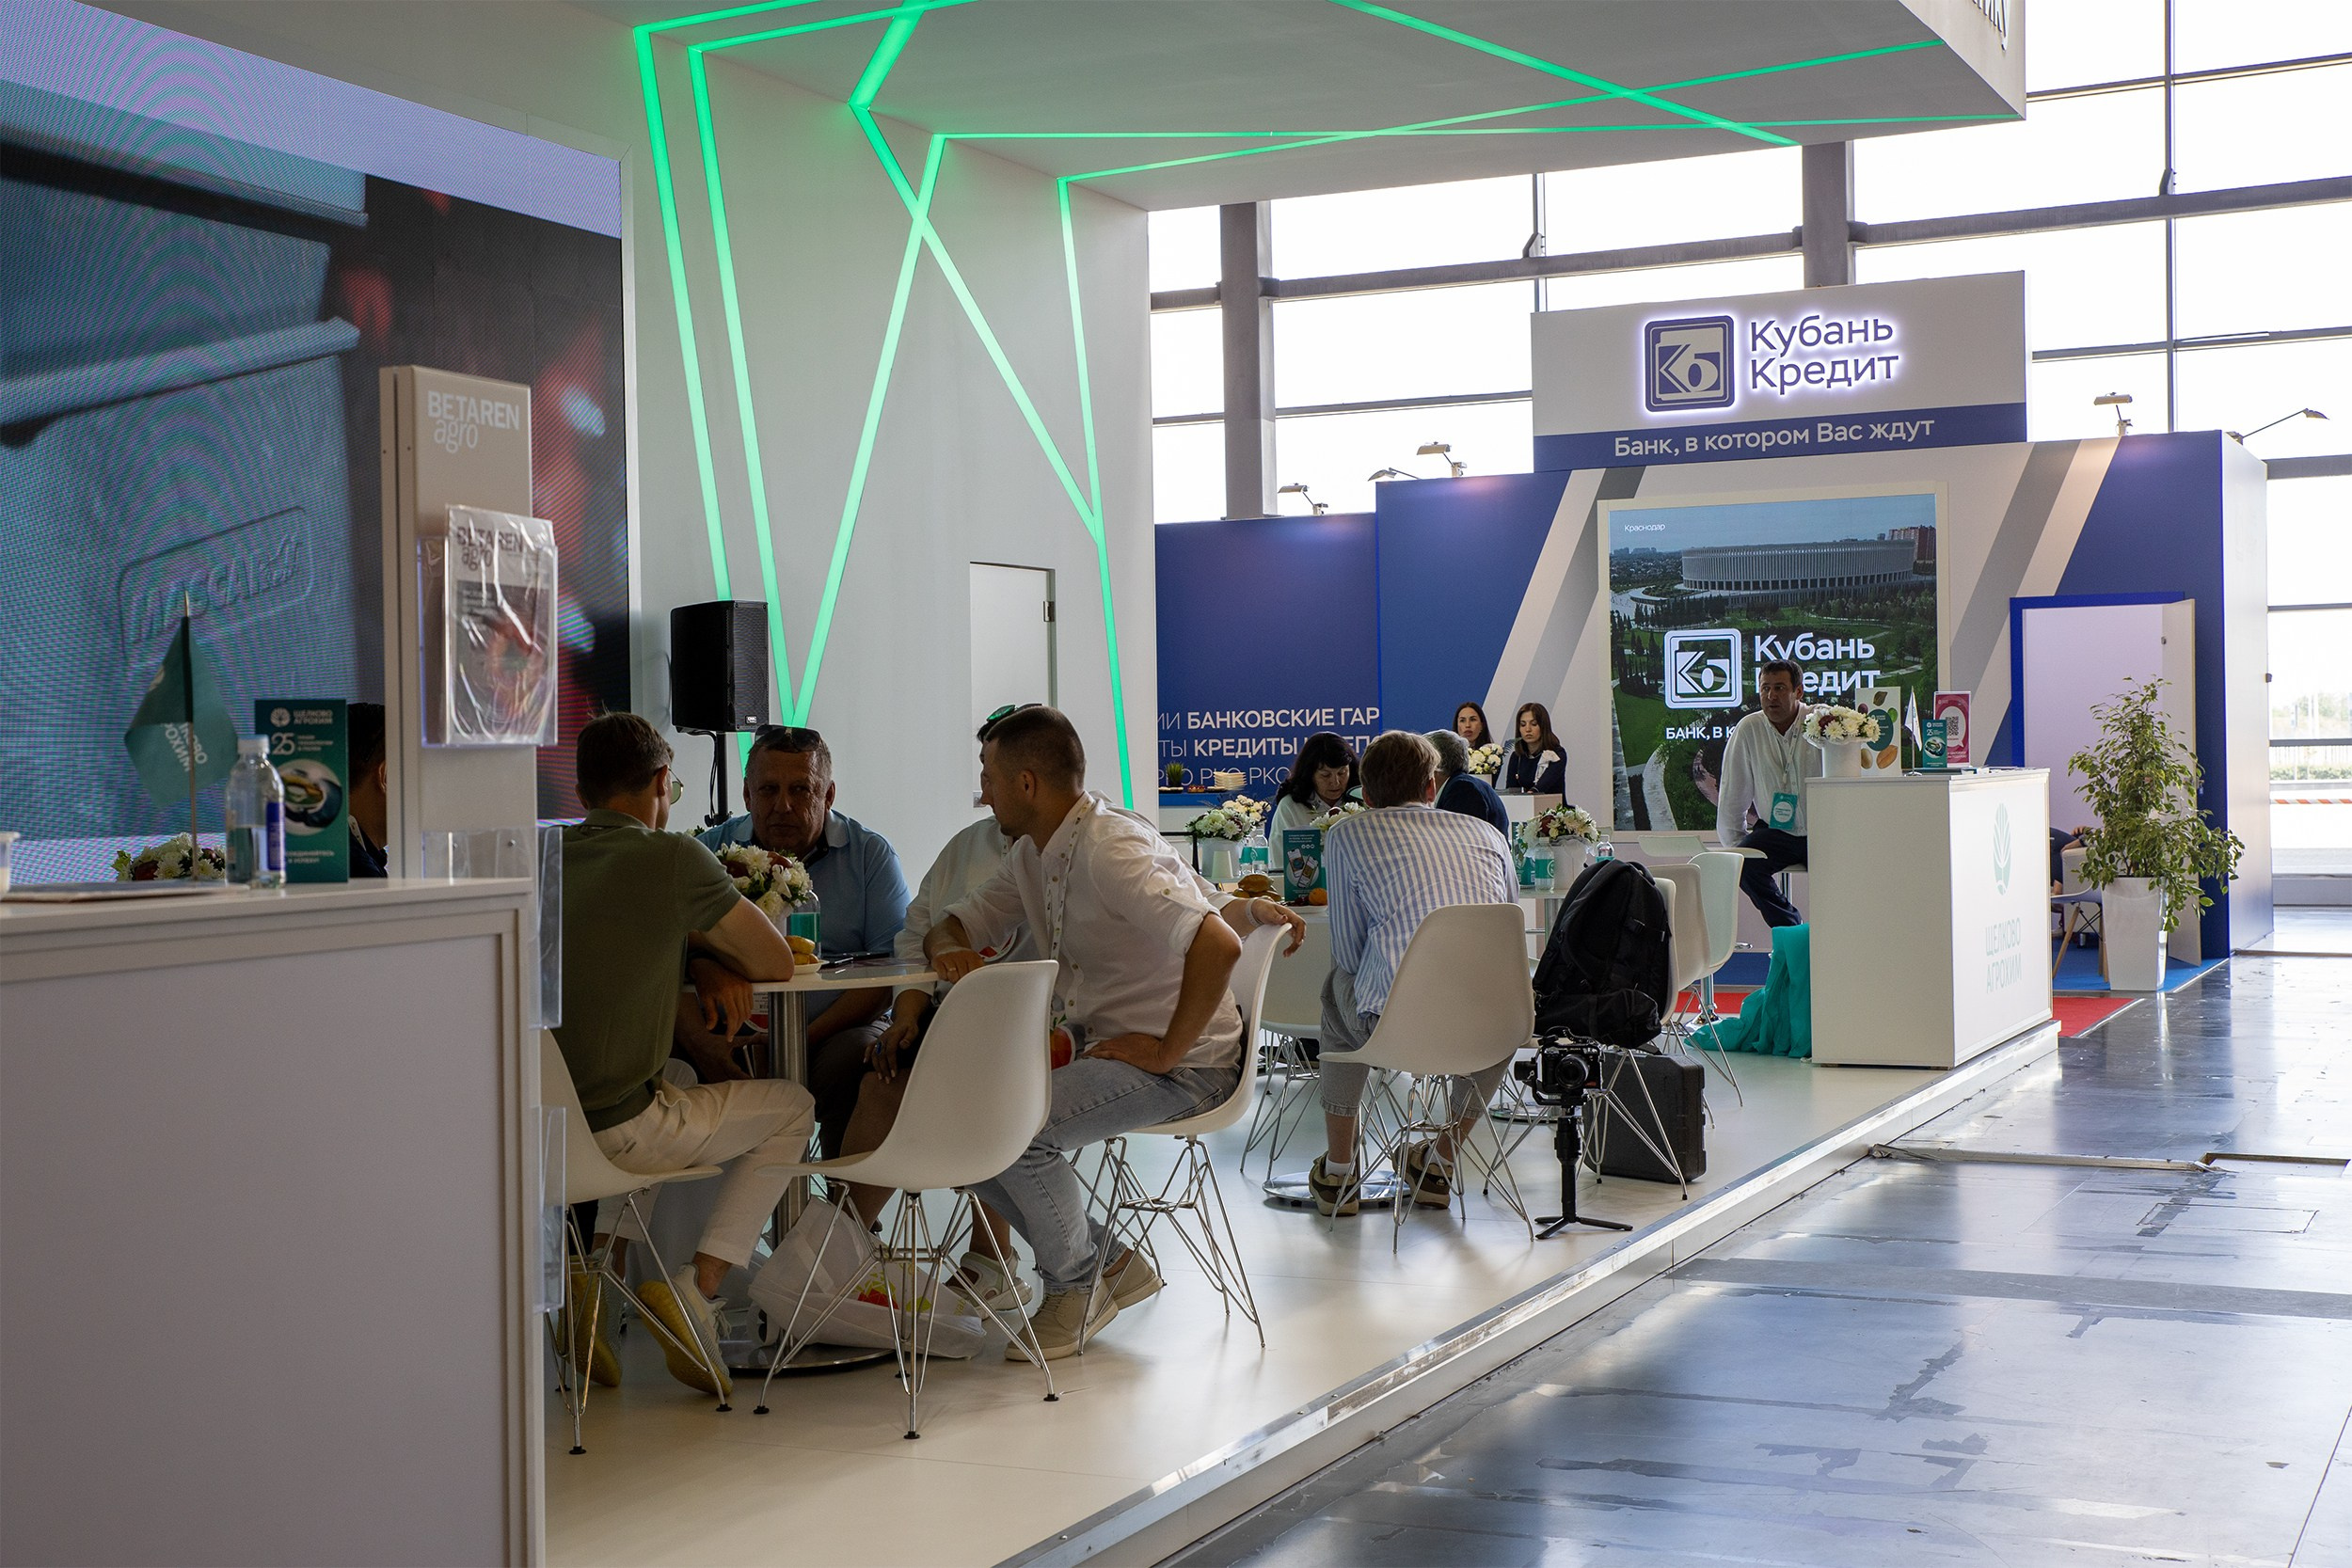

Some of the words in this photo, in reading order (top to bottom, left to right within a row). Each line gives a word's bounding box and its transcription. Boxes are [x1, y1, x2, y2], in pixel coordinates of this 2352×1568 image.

[1750, 314, 1894, 357] Кубань
[1750, 355, 1899, 396] Кредит
[427, 390, 520, 431] BETAREN
[434, 419, 479, 453] agro
[1614, 436, 1680, 457] Банк,
[1684, 436, 1698, 452] в
[1705, 426, 1810, 454] котором
[1817, 421, 1863, 444] Вас
[1868, 420, 1935, 442] ждут
[1624, 524, 1666, 533] Краснодар
[1755, 631, 1876, 661] Кубань
[1755, 666, 1882, 696] едит
[1187, 707, 1335, 730] БАНКОВСКИЕ
[1341, 706, 1380, 726] ГАР
[1665, 726, 1710, 740] БАНК,
[1712, 726, 1723, 738] В
[270, 732, 295, 755] 25
[1194, 736, 1298, 759] КРЕДИТЫ
[1249, 766, 1293, 785] РКО
[1985, 916, 2021, 957] ЩЕЛКОВО
[1986, 952, 2022, 994] АГРОХИМ
